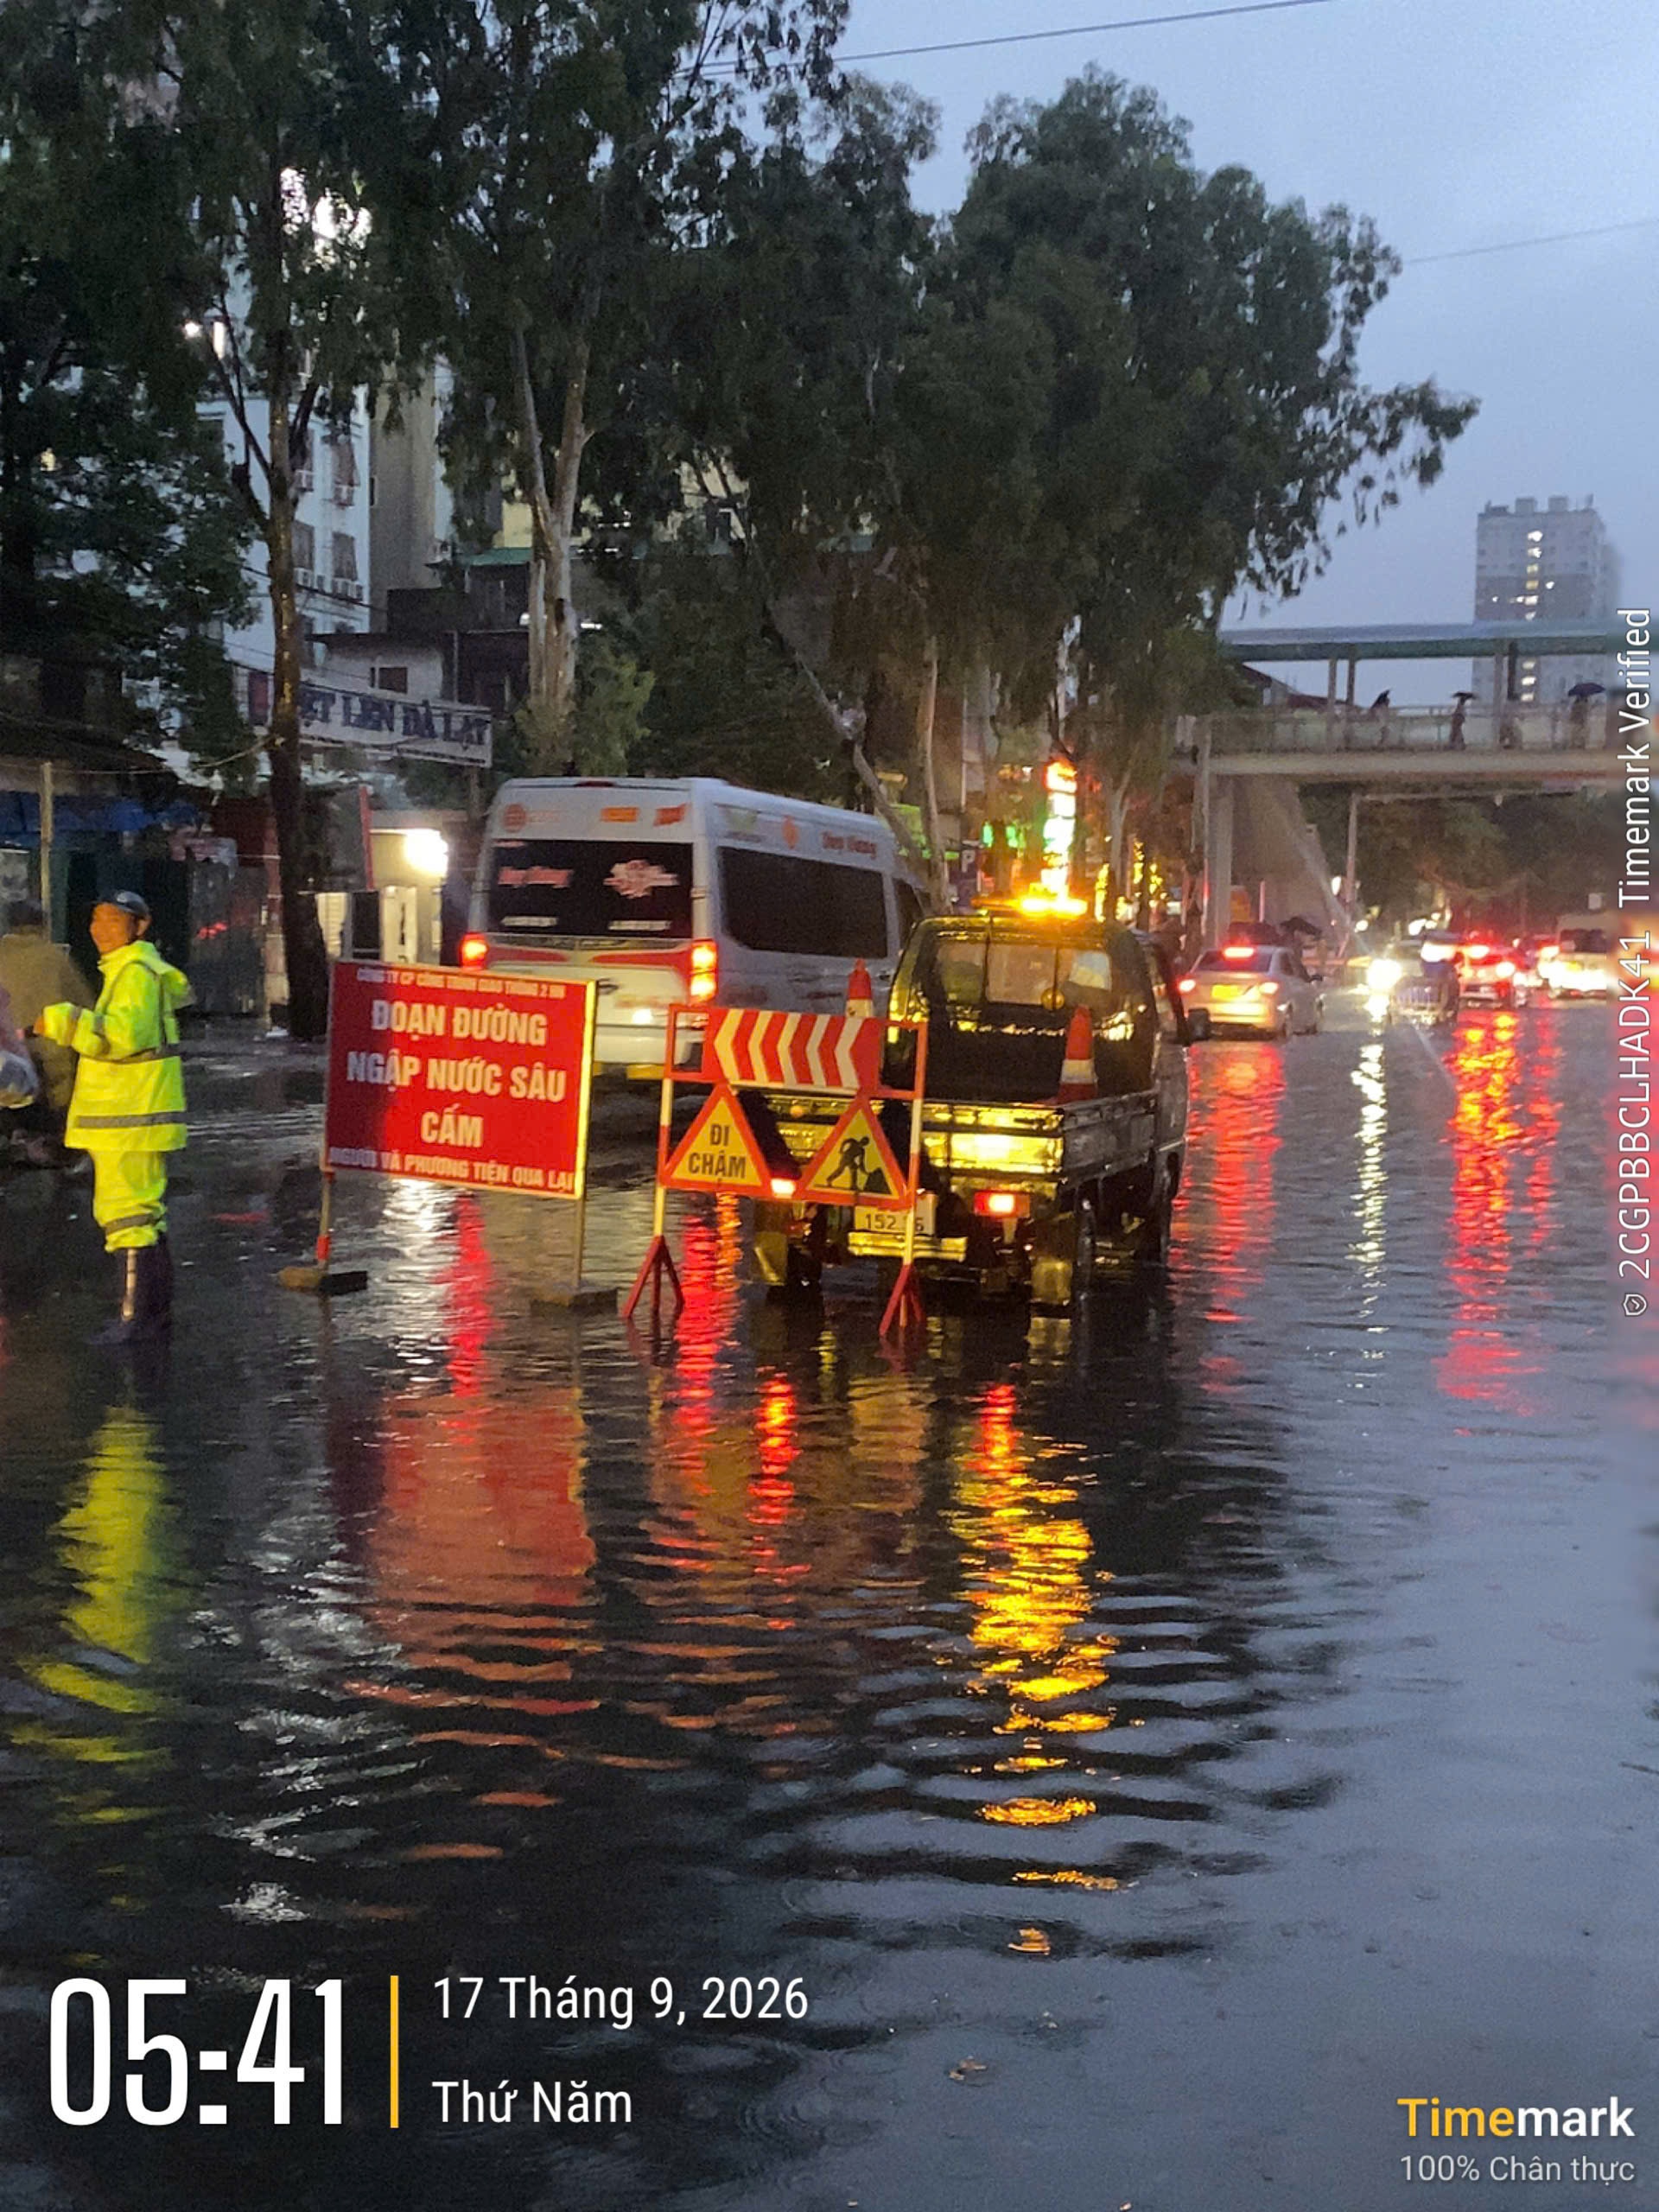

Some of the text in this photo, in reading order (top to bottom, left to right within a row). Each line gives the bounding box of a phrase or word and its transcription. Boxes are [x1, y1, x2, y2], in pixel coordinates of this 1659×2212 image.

[371, 1000, 548, 1046] ĐOẠN ĐƯỜNG
[346, 1048, 568, 1103] NGẬP NƯỚC SÂU
[420, 1103, 485, 1148] CẤM
[709, 1123, 730, 1147] ĐI
[512, 1166, 545, 1187] QUA
[548, 1168, 575, 1192] LẠI
[688, 1150, 747, 1186] CHẬM
